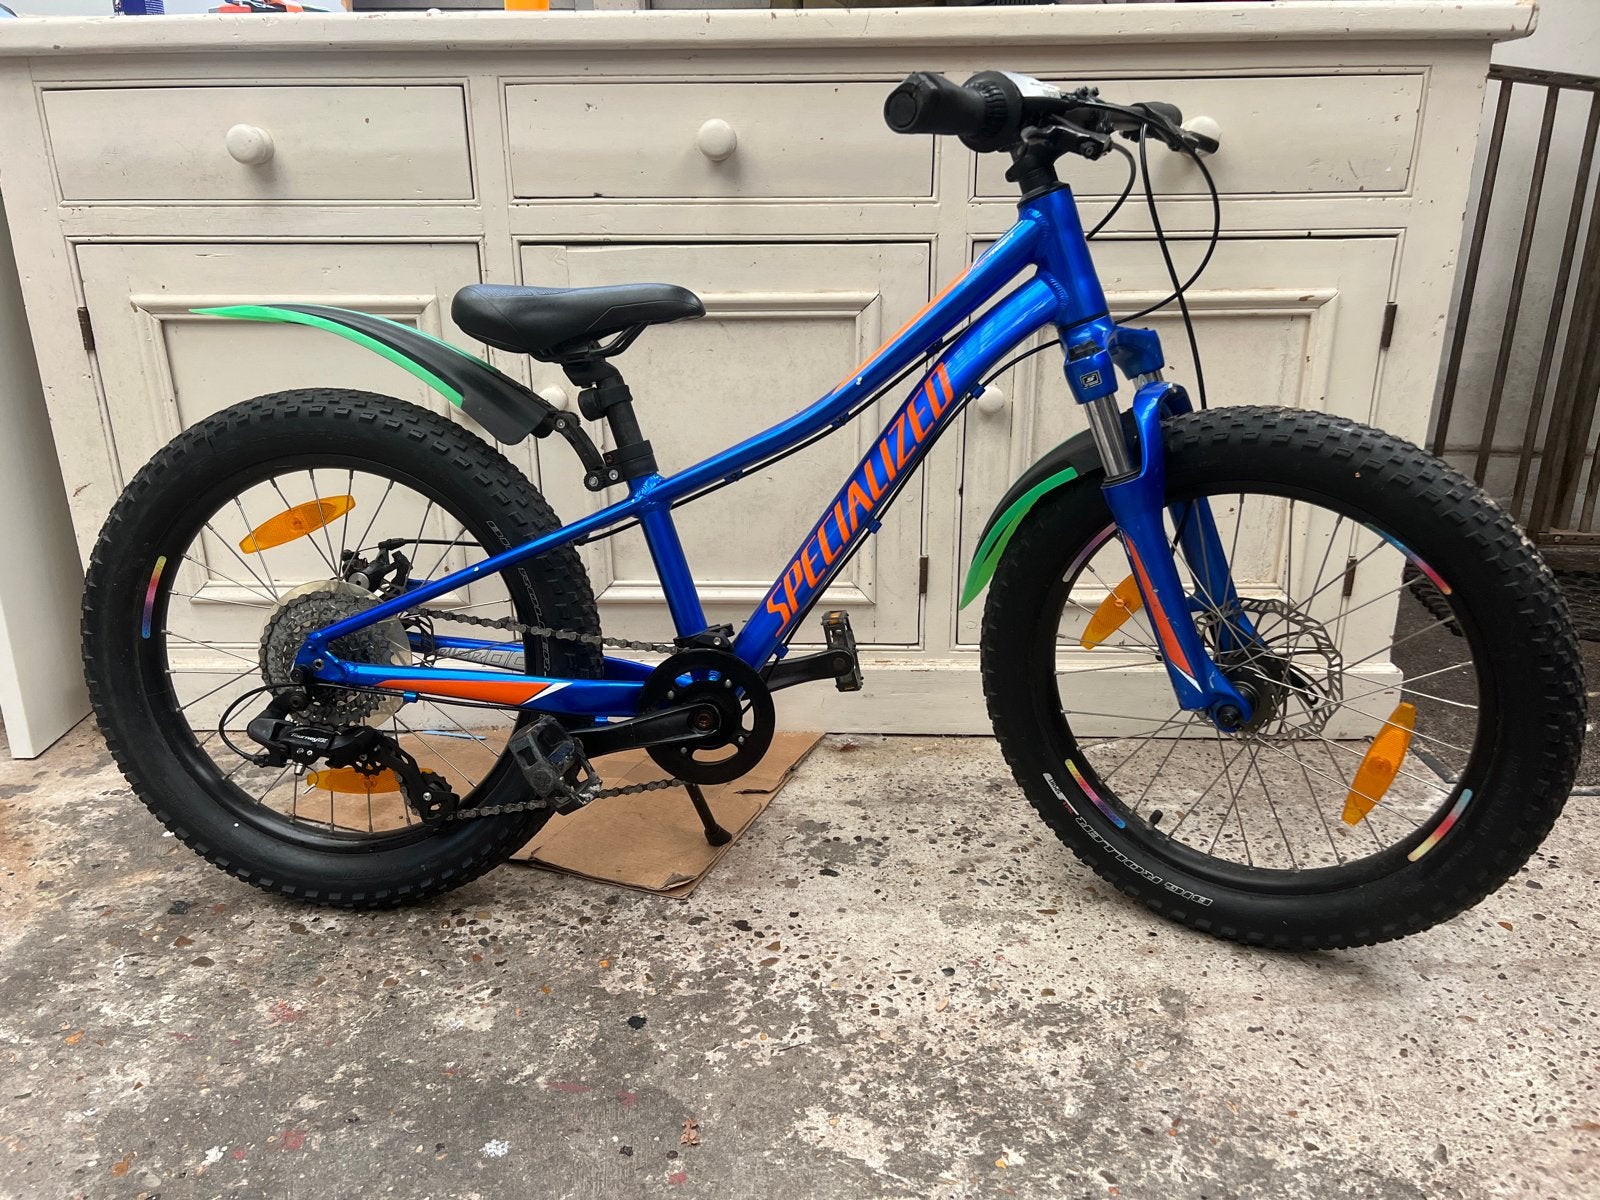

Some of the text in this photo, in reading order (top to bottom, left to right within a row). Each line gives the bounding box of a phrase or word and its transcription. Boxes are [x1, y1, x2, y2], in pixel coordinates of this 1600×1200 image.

[766, 362, 954, 637] SPECIALIZED
[1075, 816, 1163, 885] ROLLER
[1164, 881, 1213, 907] BIG
